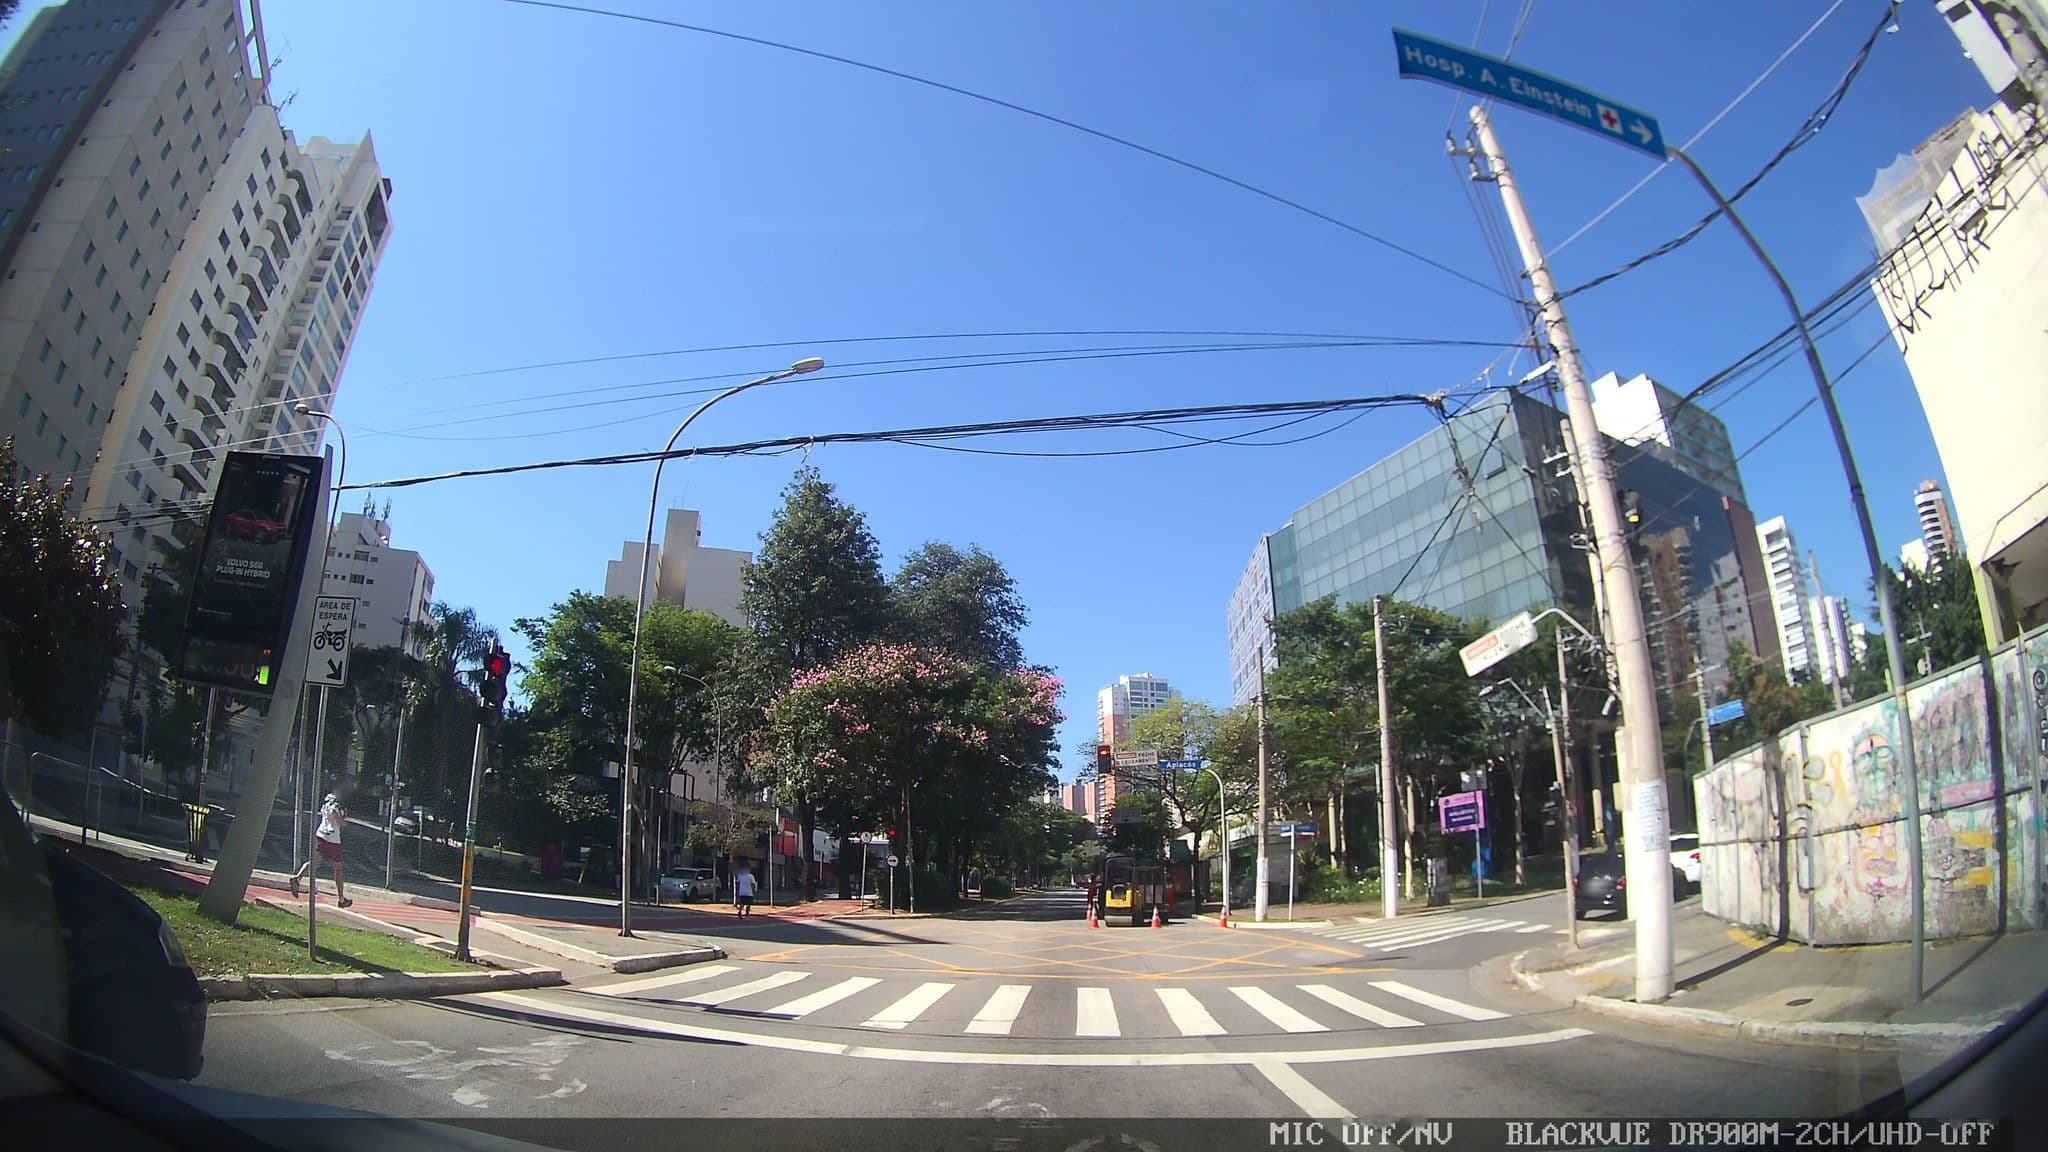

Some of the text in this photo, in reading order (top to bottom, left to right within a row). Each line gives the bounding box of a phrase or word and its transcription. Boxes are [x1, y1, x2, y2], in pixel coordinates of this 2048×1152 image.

[1404, 45, 1593, 119] Hosp. A. Einstein
[226, 558, 264, 569] VOLVO S60
[216, 565, 271, 579] PLUG-IN HYBRID
[341, 602, 352, 610] DE
[319, 612, 347, 621] ESPERA
